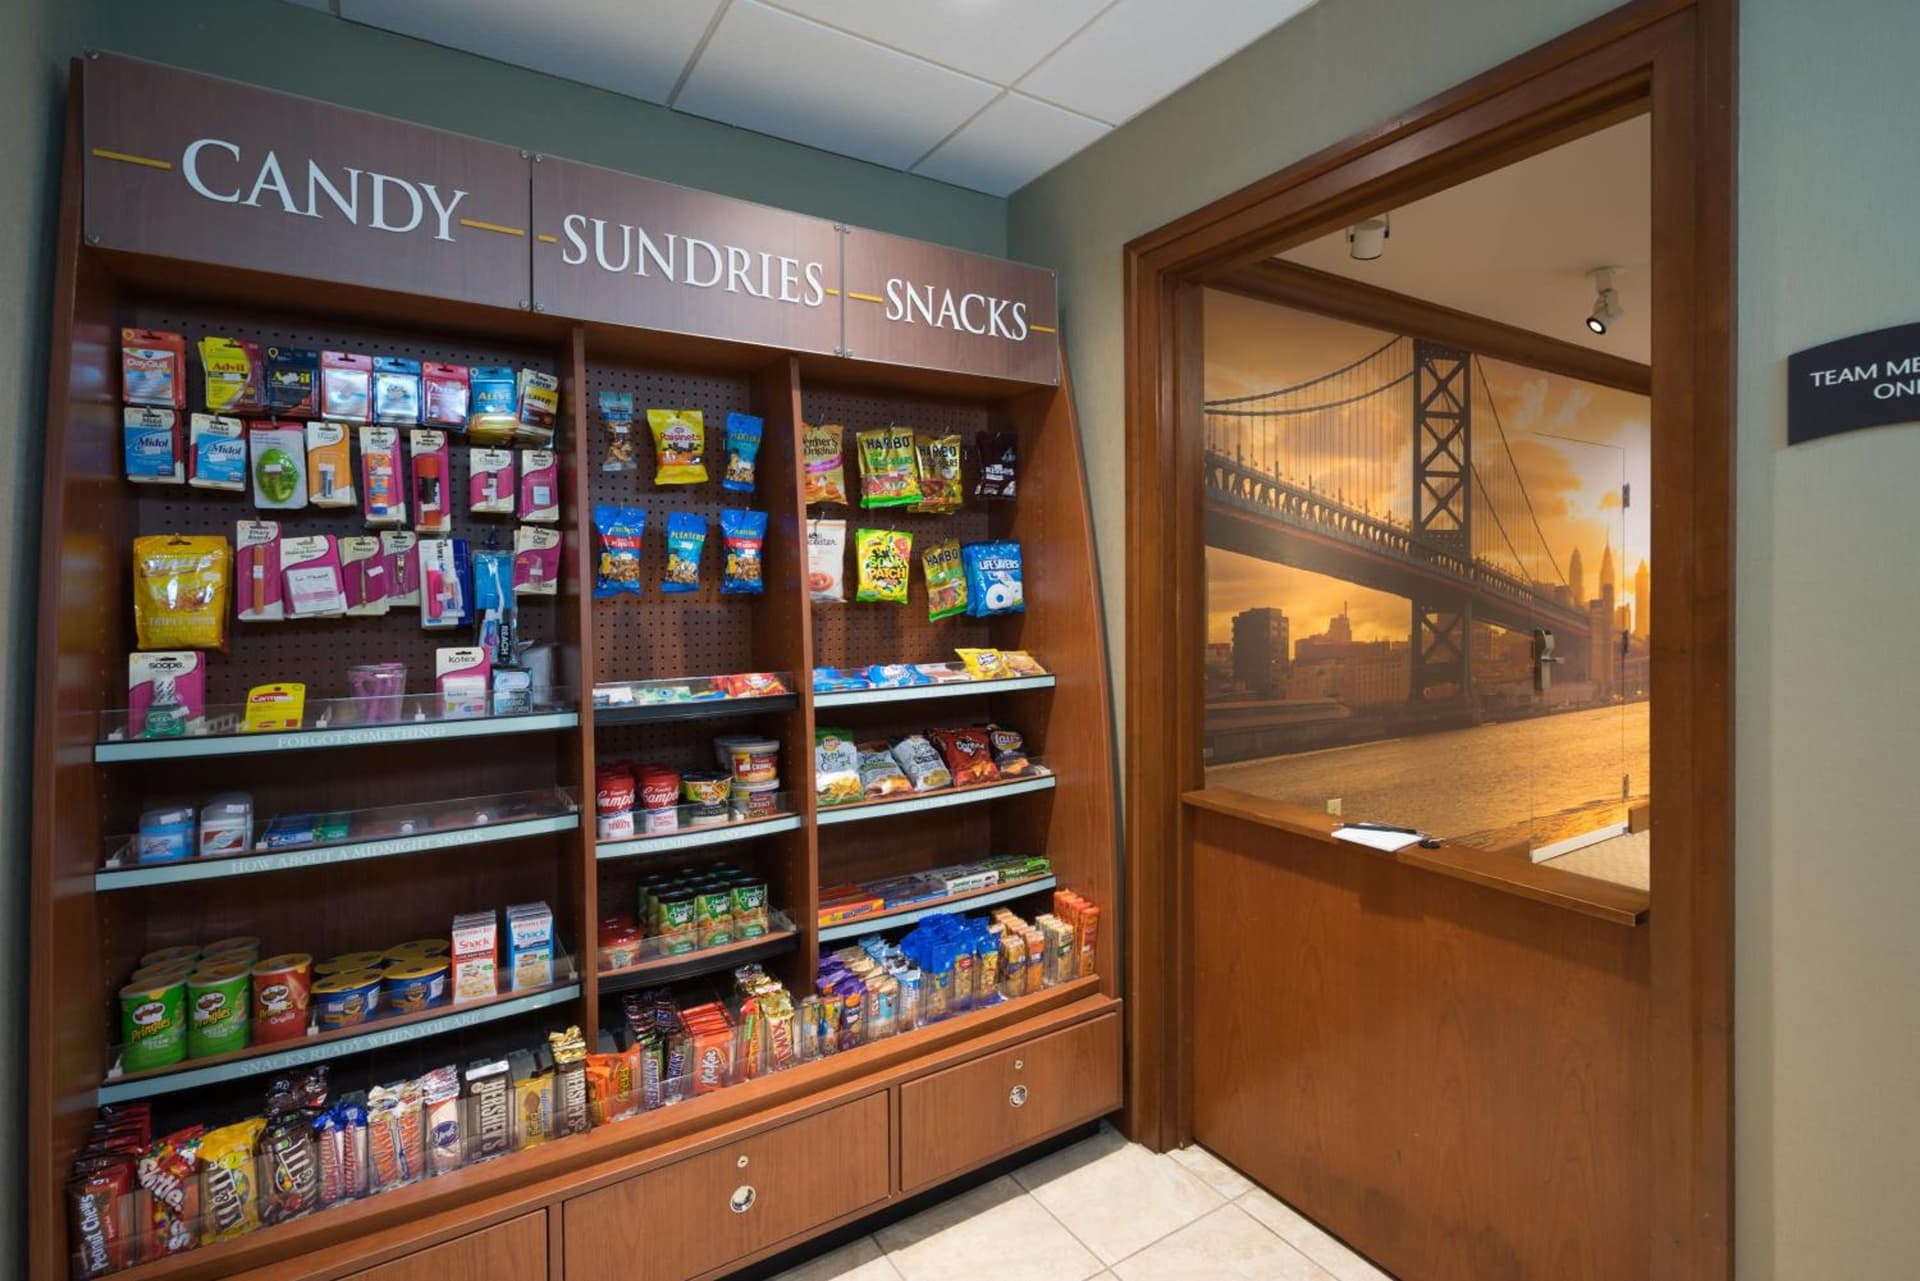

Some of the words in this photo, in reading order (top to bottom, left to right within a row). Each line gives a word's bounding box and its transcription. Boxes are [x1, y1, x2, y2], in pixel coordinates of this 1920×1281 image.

[182, 138, 469, 242] CANDY
[562, 213, 826, 308] SUNDRIES
[884, 277, 1029, 342] SNACKS
[213, 362, 246, 372] Advil
[272, 371, 311, 382] Ail
[1809, 362, 1878, 387] TEAM
[137, 437, 169, 447] Midol
[211, 443, 243, 455] Midol
[869, 567, 906, 579] PATCH
[500, 625, 509, 656] REACH
[149, 661, 182, 671] scope
[278, 736, 348, 748] FORGOT
[231, 859, 270, 874] HOW
[279, 849, 332, 868] ABOUT
[459, 938, 490, 949] Snack
[519, 930, 546, 939] Snack
[131, 1017, 171, 1042] Pringles
[239, 1052, 306, 1074] SNACKS
[367, 1027, 417, 1048] WHEN
[564, 1070, 586, 1131] HERSHEY'S
[480, 1078, 506, 1151] HERSHEY'S
[80, 1194, 100, 1231] Chews
[84, 1231, 109, 1271] Peanut
